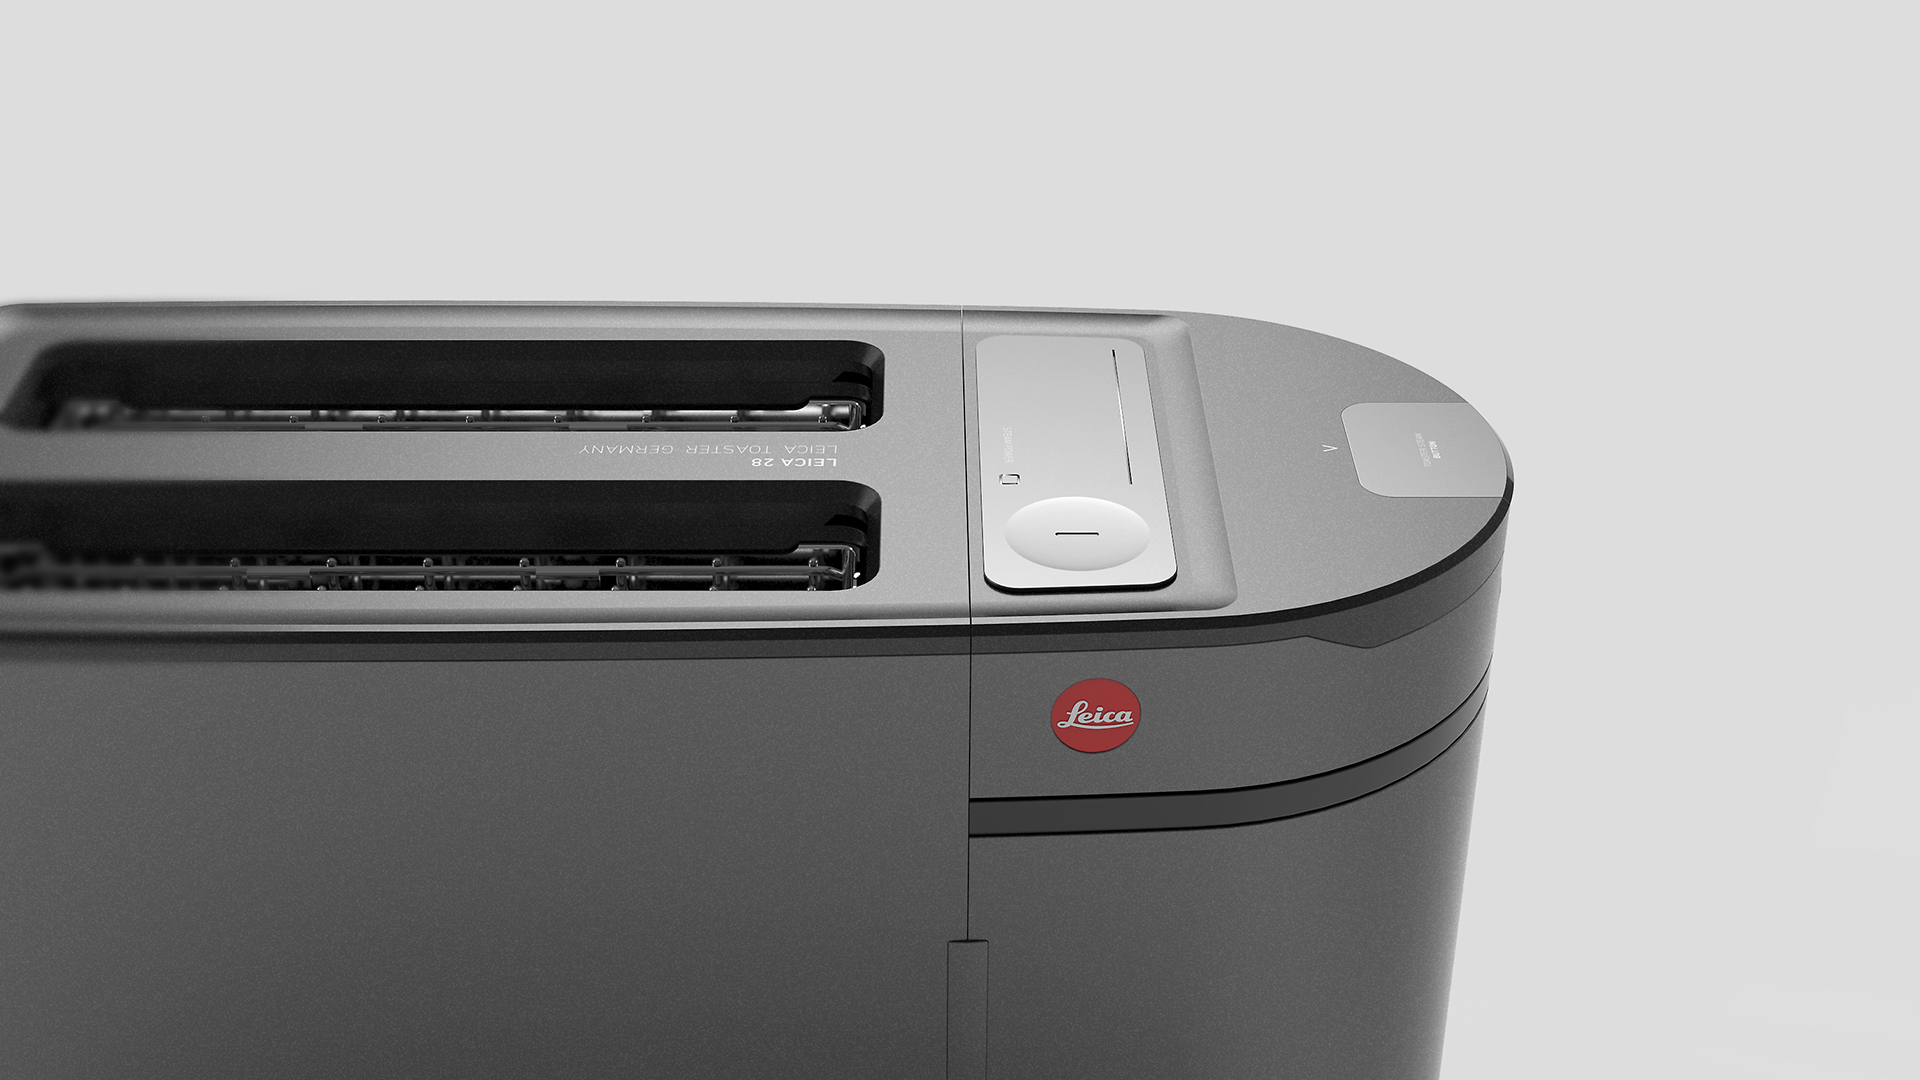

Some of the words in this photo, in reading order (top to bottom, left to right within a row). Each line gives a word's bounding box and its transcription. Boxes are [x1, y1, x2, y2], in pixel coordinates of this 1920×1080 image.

[579, 445, 674, 454] GERMANY
[685, 445, 772, 454] TOASTER
[784, 445, 838, 454] LEICA
[751, 458, 774, 467] 28
[781, 458, 837, 467] LEICA
[1056, 700, 1134, 730] Leica
